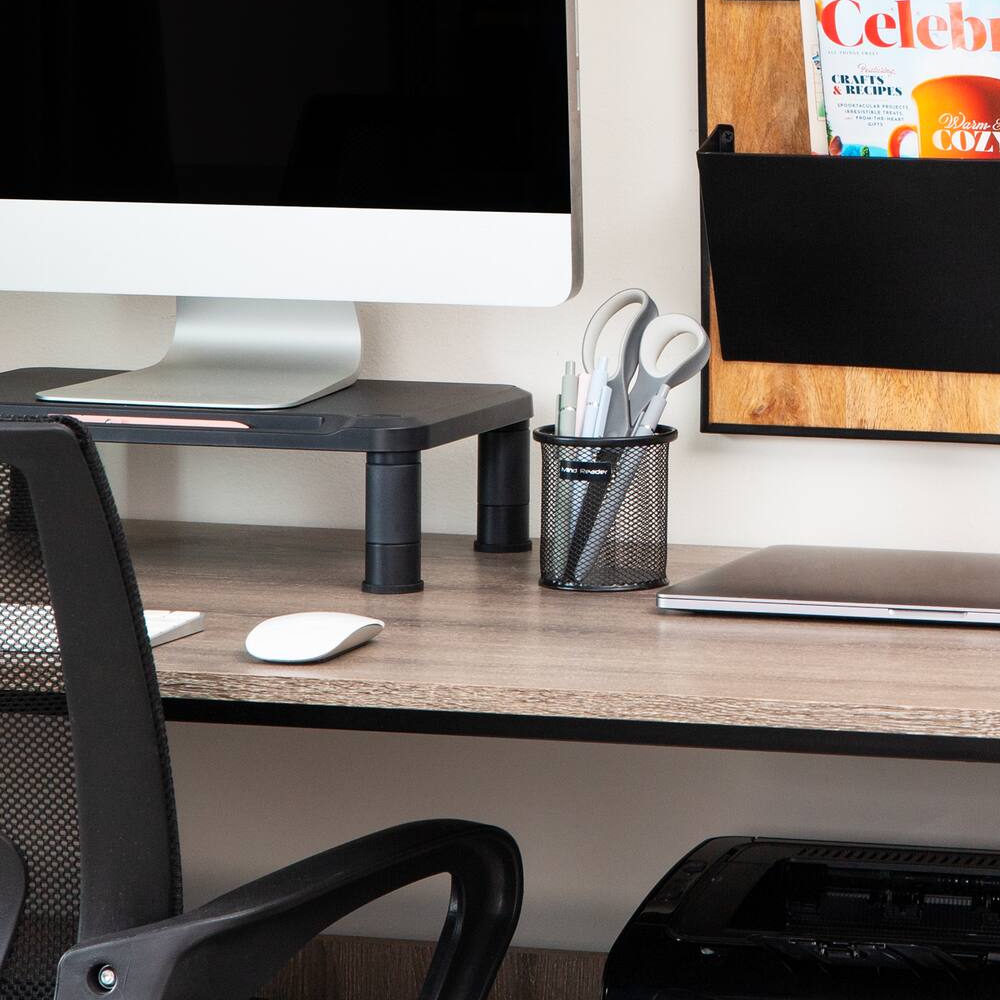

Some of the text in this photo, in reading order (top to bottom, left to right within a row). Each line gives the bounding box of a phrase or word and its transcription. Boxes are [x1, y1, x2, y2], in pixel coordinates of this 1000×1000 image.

[831, 74, 885, 85] CRAFTS
[832, 85, 903, 97] & RECIPES
[938, 111, 991, 130] Warm
